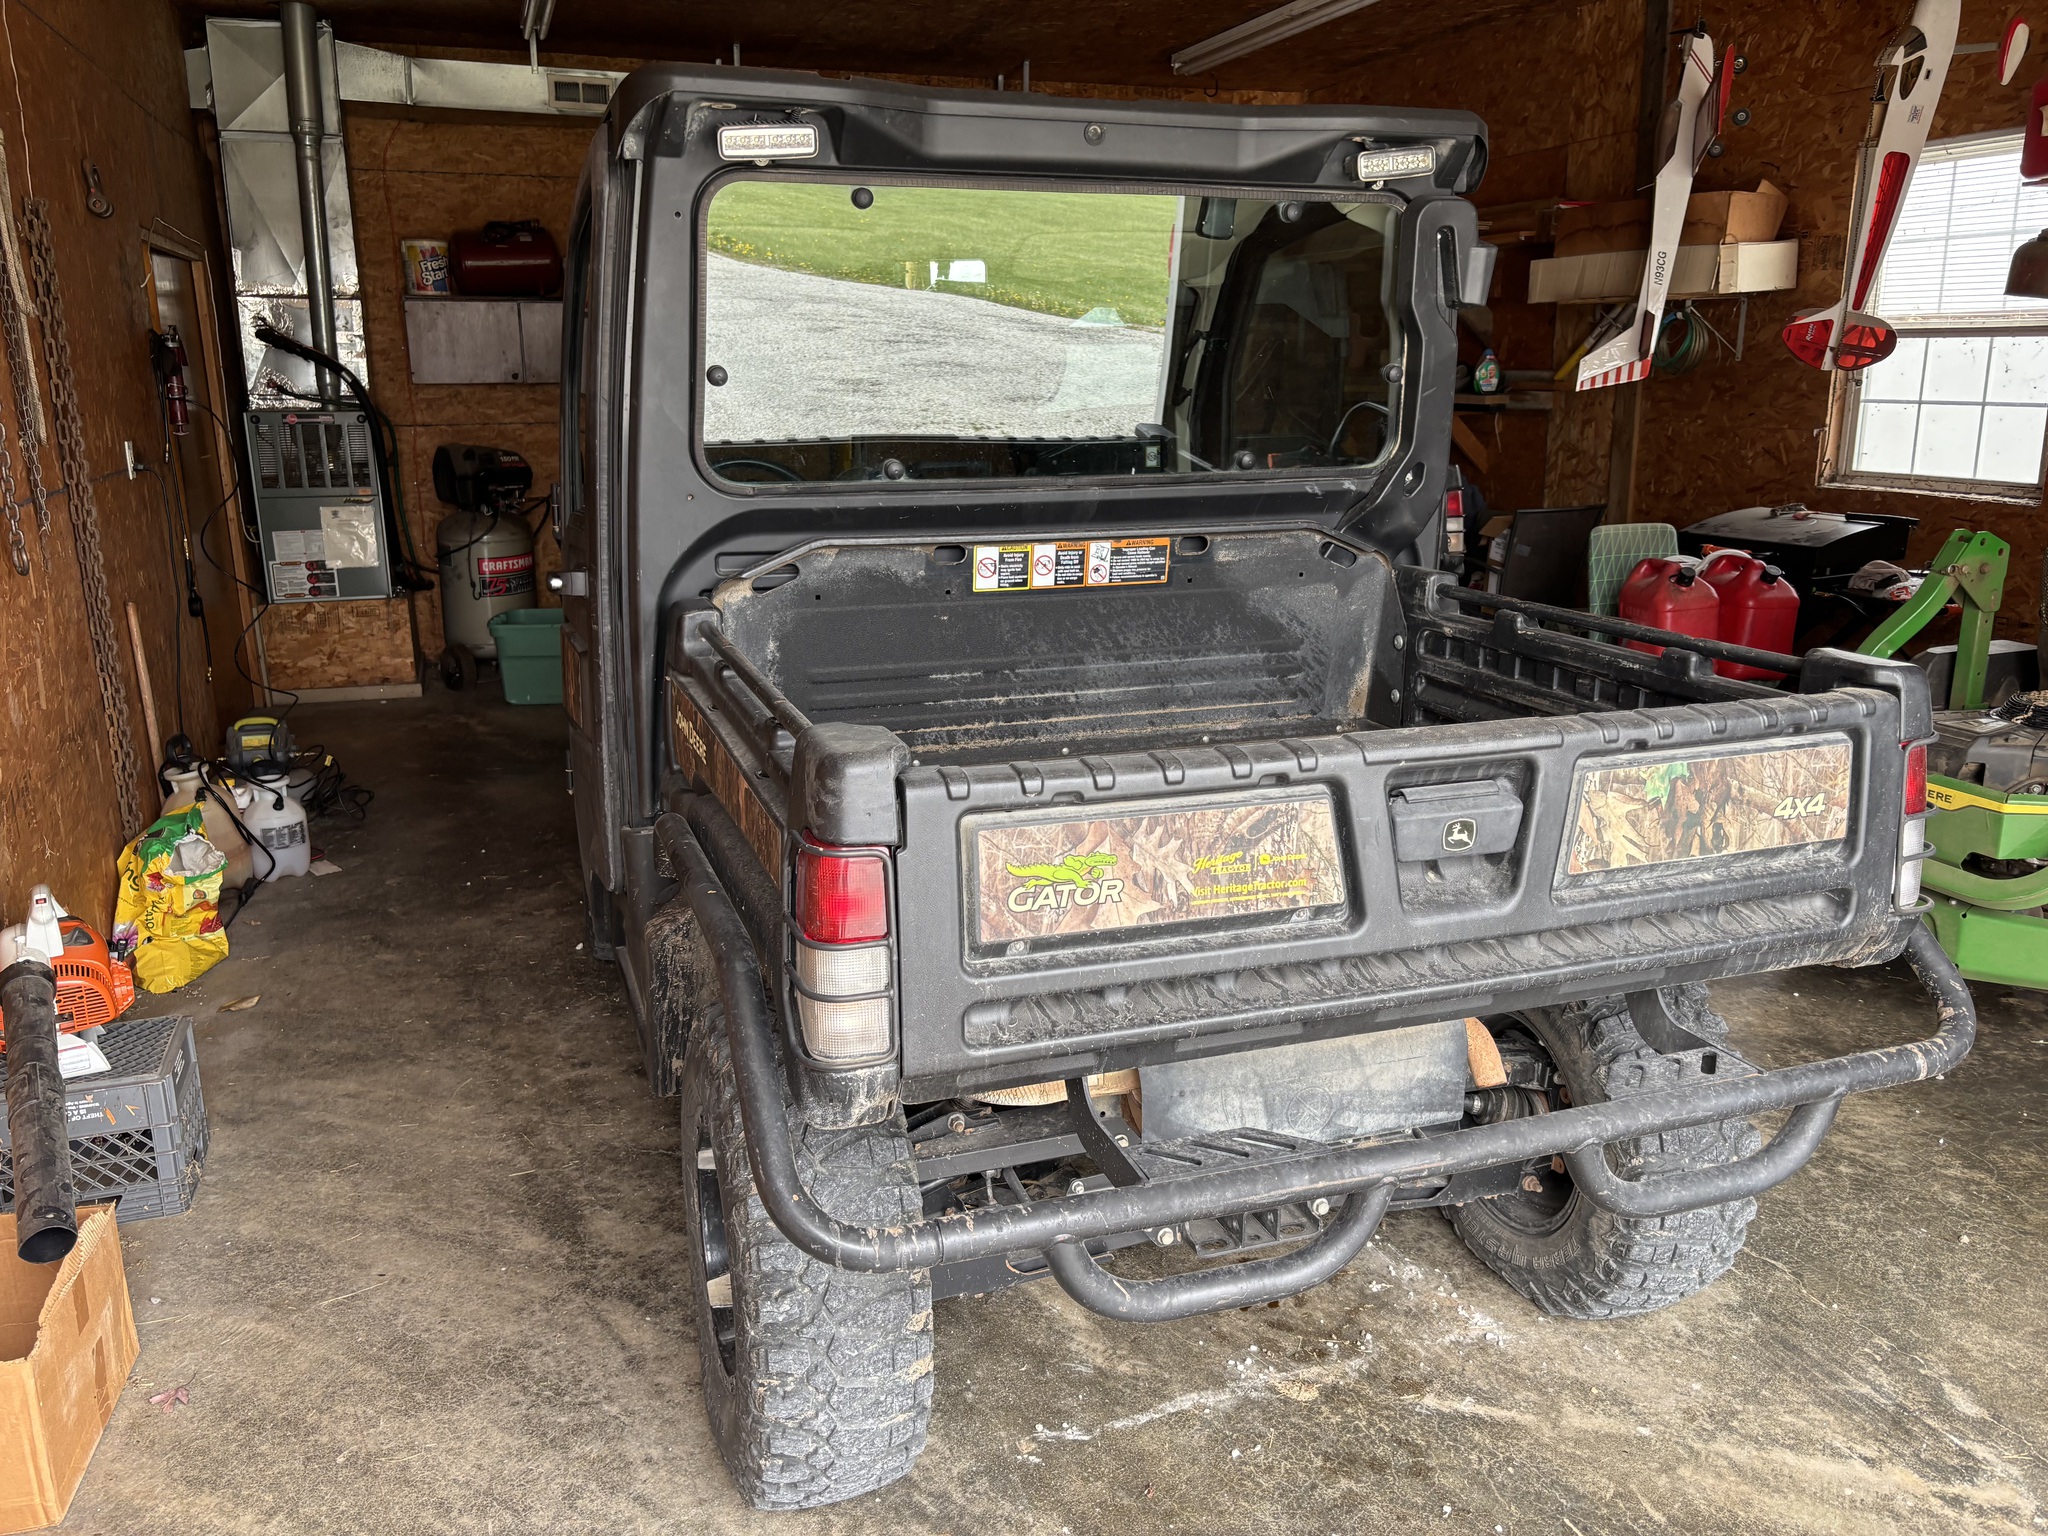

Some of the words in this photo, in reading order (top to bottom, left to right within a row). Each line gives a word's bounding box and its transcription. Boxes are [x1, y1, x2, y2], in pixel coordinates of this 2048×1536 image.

[420, 256, 449, 272] Fresh
[1653, 251, 1667, 286] N93CG
[421, 268, 449, 286] Start
[482, 557, 533, 572] CRAFTSMAN
[688, 720, 707, 766] DEERE
[1927, 789, 1952, 804] ERE
[1192, 851, 1243, 874] Heritage
[1210, 864, 1251, 875] TRACTOR
[1007, 879, 1124, 913] GATOR
[1192, 884, 1211, 896] Visit
[1213, 878, 1306, 895] HeritageTractor.com
[71, 1114, 81, 1122] OF
[84, 1112, 104, 1121] THEFT
[1459, 1209, 1527, 1267] MASTER
[1532, 1237, 1581, 1270] TERRA
